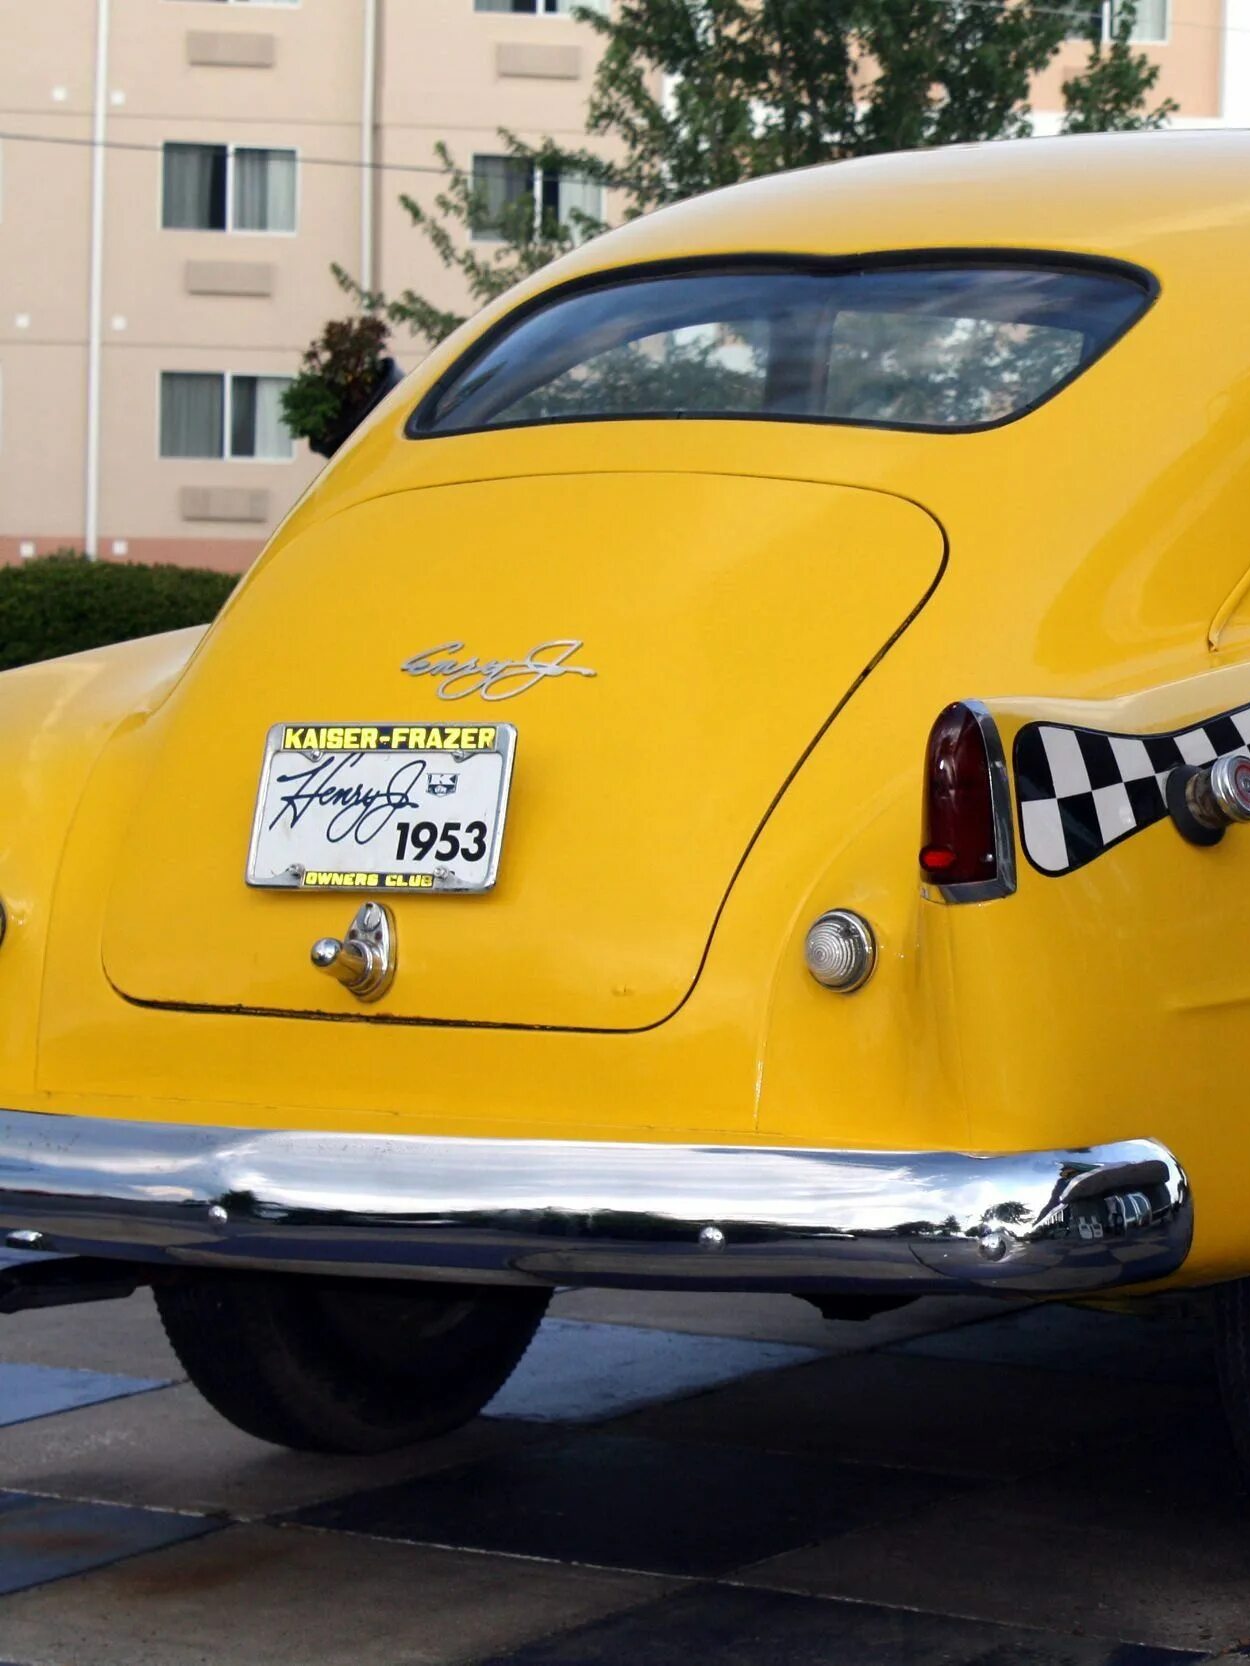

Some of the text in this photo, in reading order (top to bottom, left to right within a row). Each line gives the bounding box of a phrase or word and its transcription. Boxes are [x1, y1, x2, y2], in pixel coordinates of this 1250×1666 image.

[284, 727, 496, 750] KAISER-FRAZER
[269, 752, 380, 843] Henry
[396, 820, 488, 862] 1953
[305, 872, 433, 887] OWNERS CLUB
